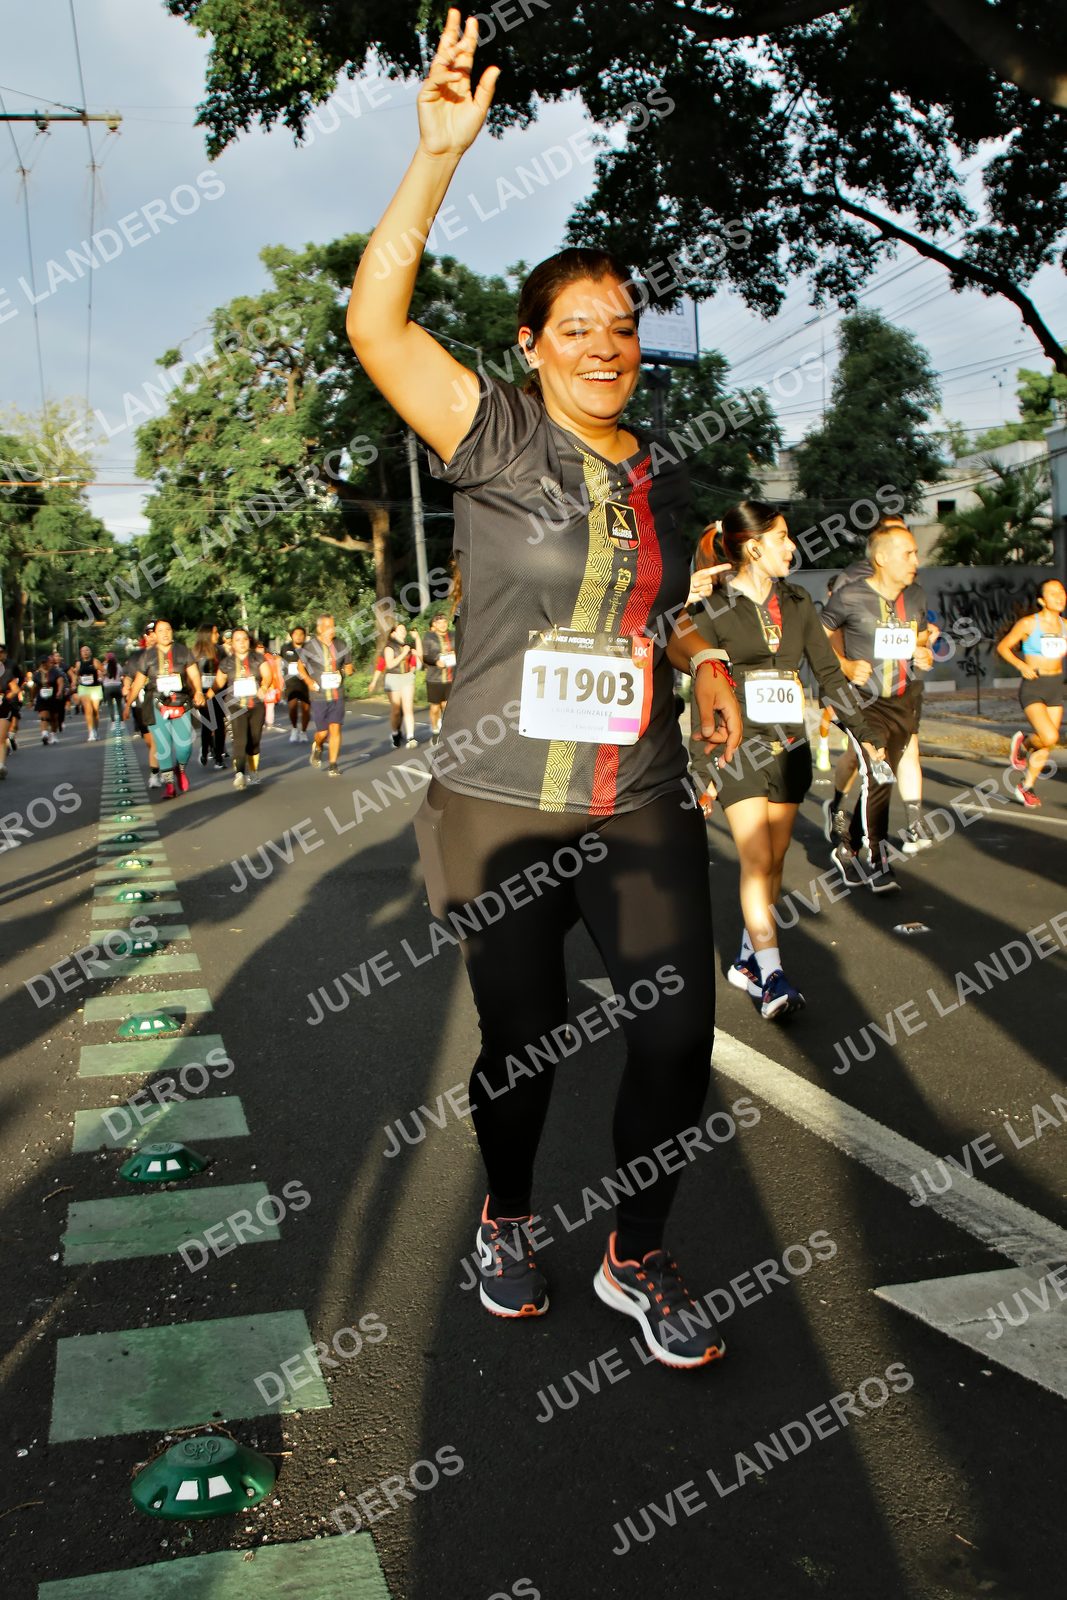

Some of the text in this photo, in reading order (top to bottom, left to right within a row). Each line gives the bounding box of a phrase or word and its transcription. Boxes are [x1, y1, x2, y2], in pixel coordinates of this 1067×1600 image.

[882, 634, 909, 644] 4164
[532, 665, 634, 706] 11903
[757, 687, 794, 703] 5206
